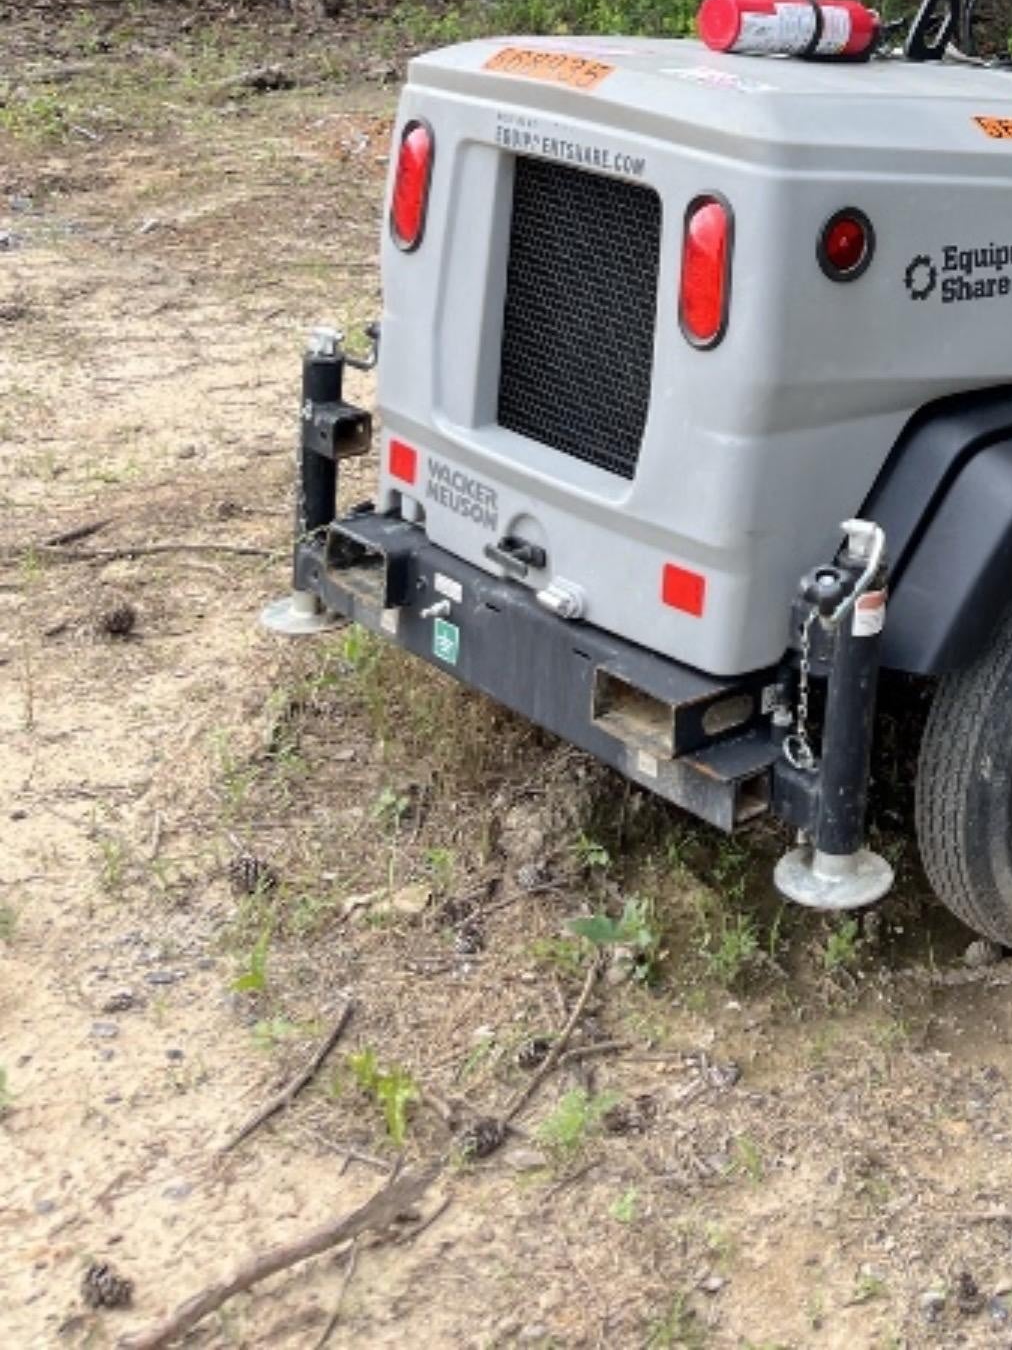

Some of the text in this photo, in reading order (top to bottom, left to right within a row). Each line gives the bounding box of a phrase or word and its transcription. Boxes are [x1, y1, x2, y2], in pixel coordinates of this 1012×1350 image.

[941, 275, 1011, 303] Share
[426, 479, 498, 531] NEUSON
[428, 456, 498, 509] WACKER
